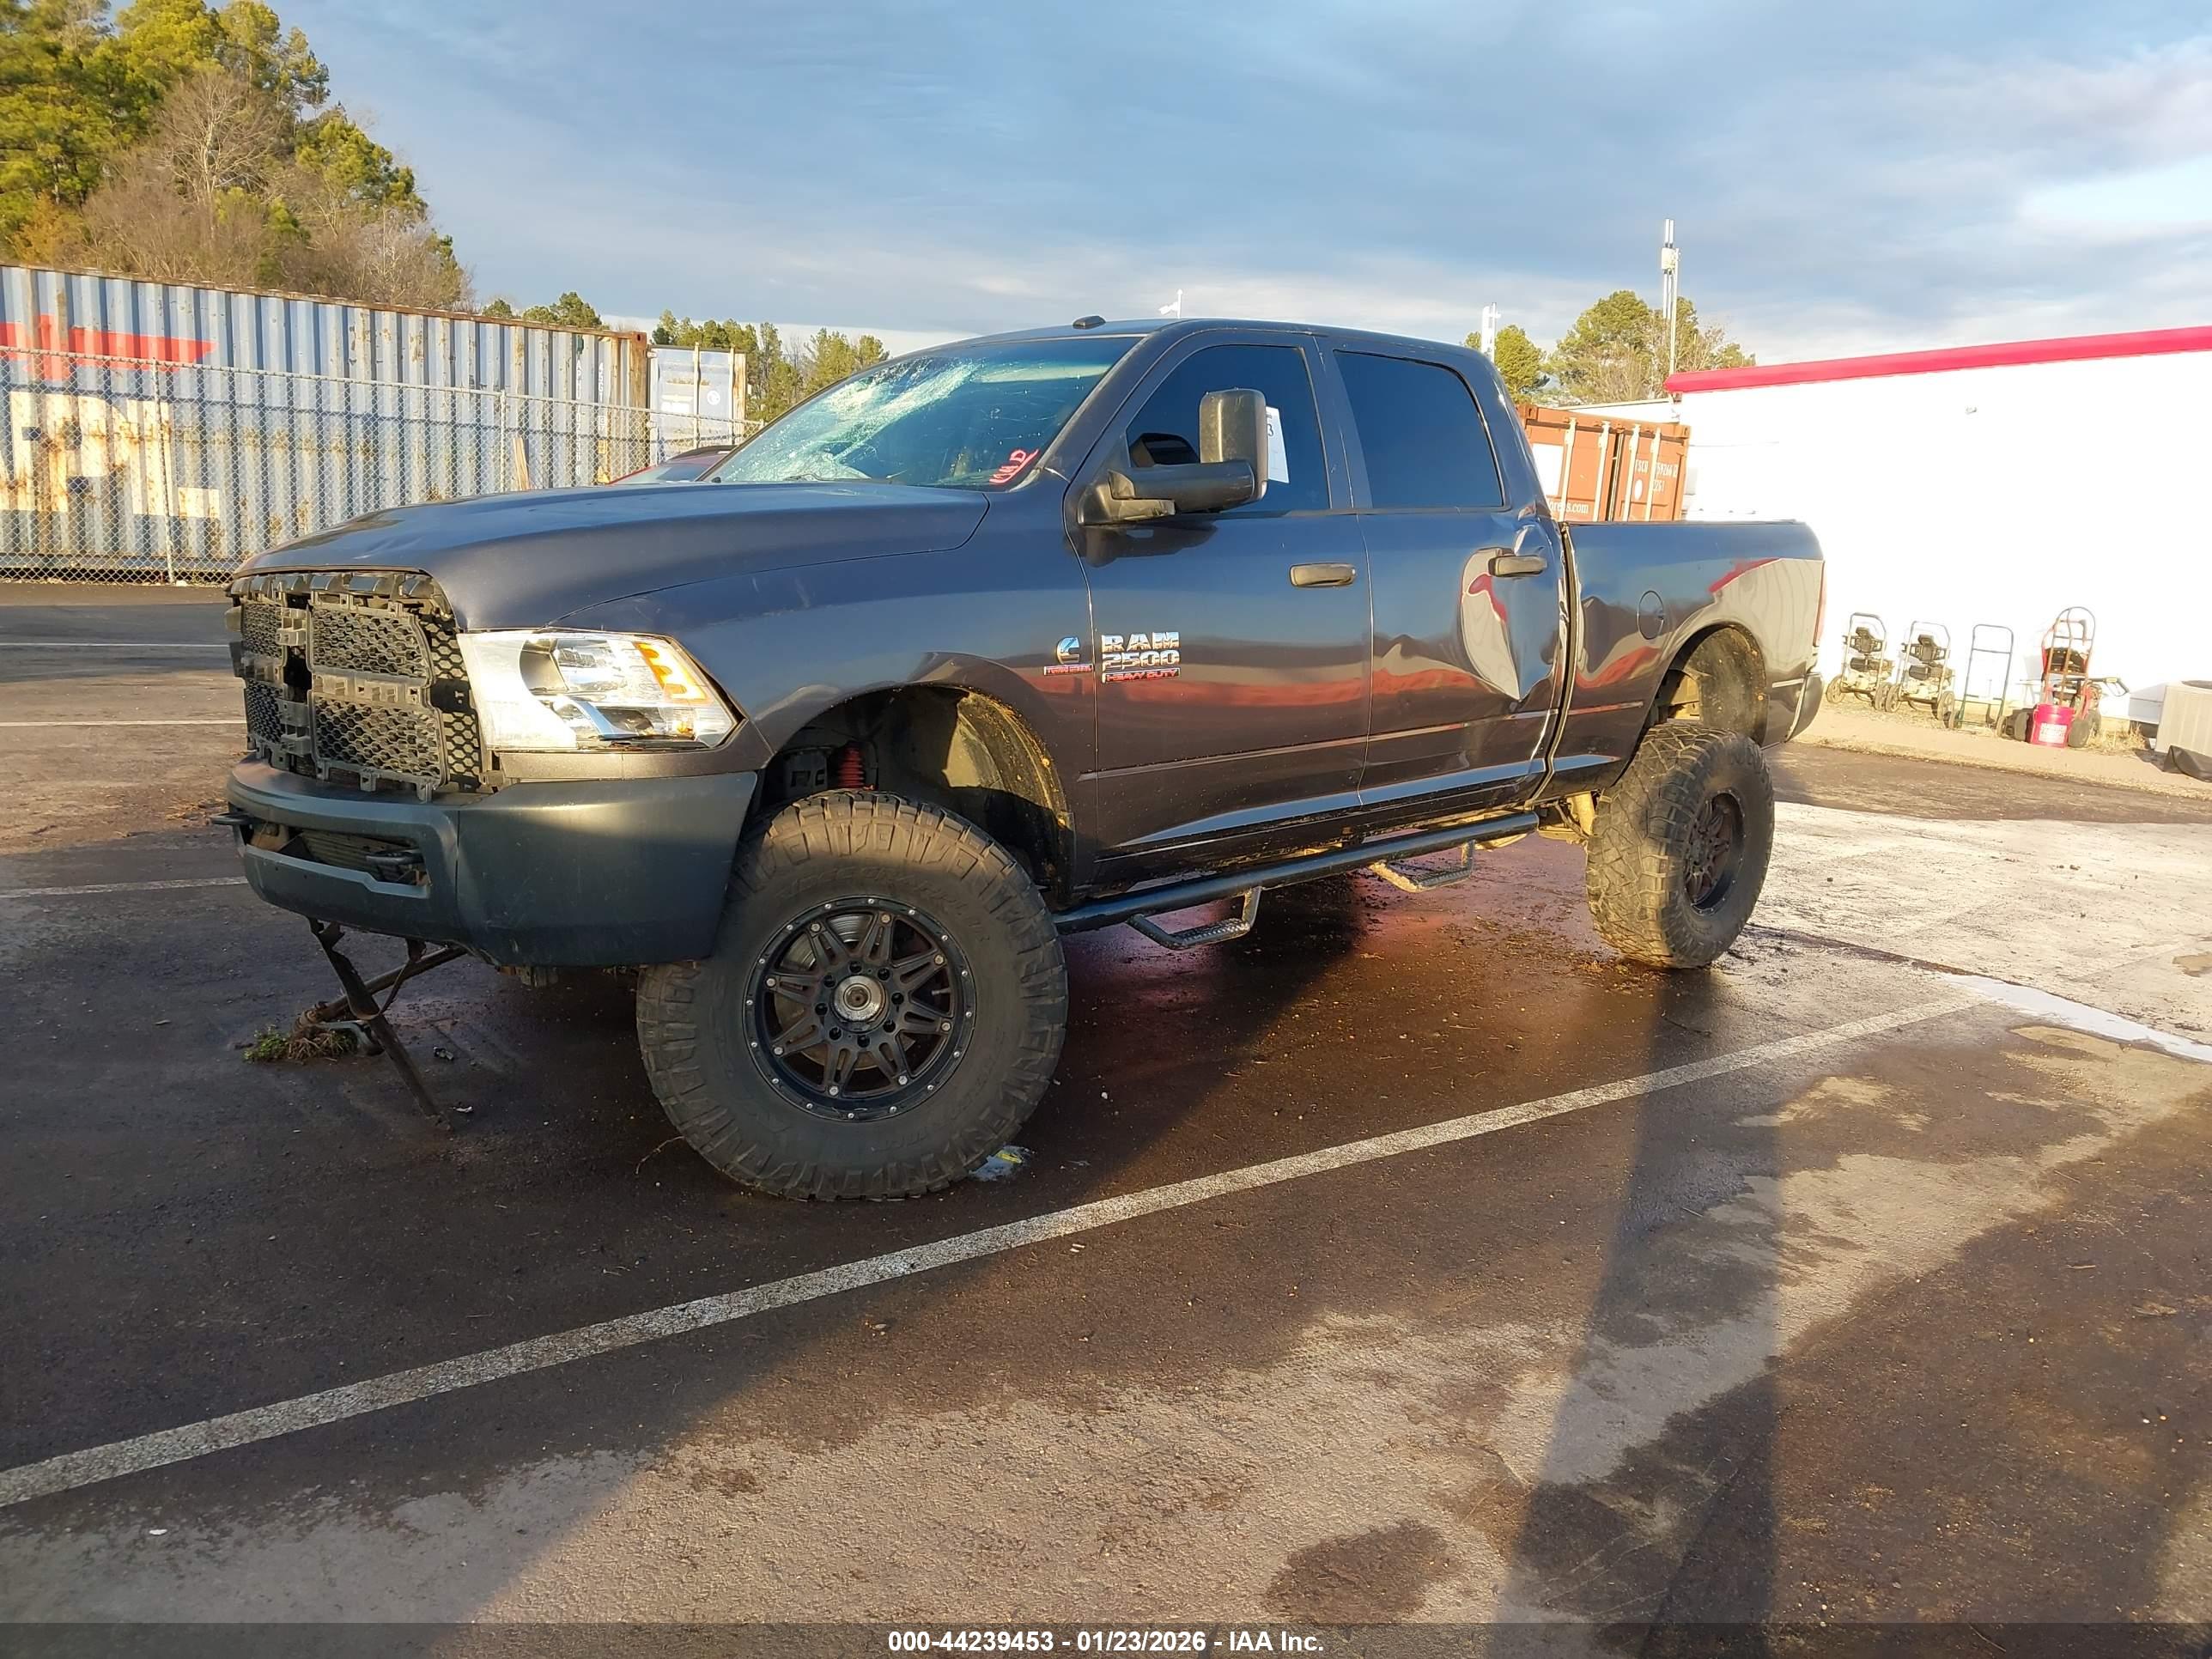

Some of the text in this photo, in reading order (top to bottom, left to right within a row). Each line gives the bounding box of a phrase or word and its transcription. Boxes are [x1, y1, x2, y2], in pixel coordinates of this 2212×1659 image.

[0, 391, 220, 519] PL
[1101, 631, 1180, 653] RAM
[1101, 649, 1181, 672] 2500
[1107, 669, 1177, 682] HEAVY DUTY
